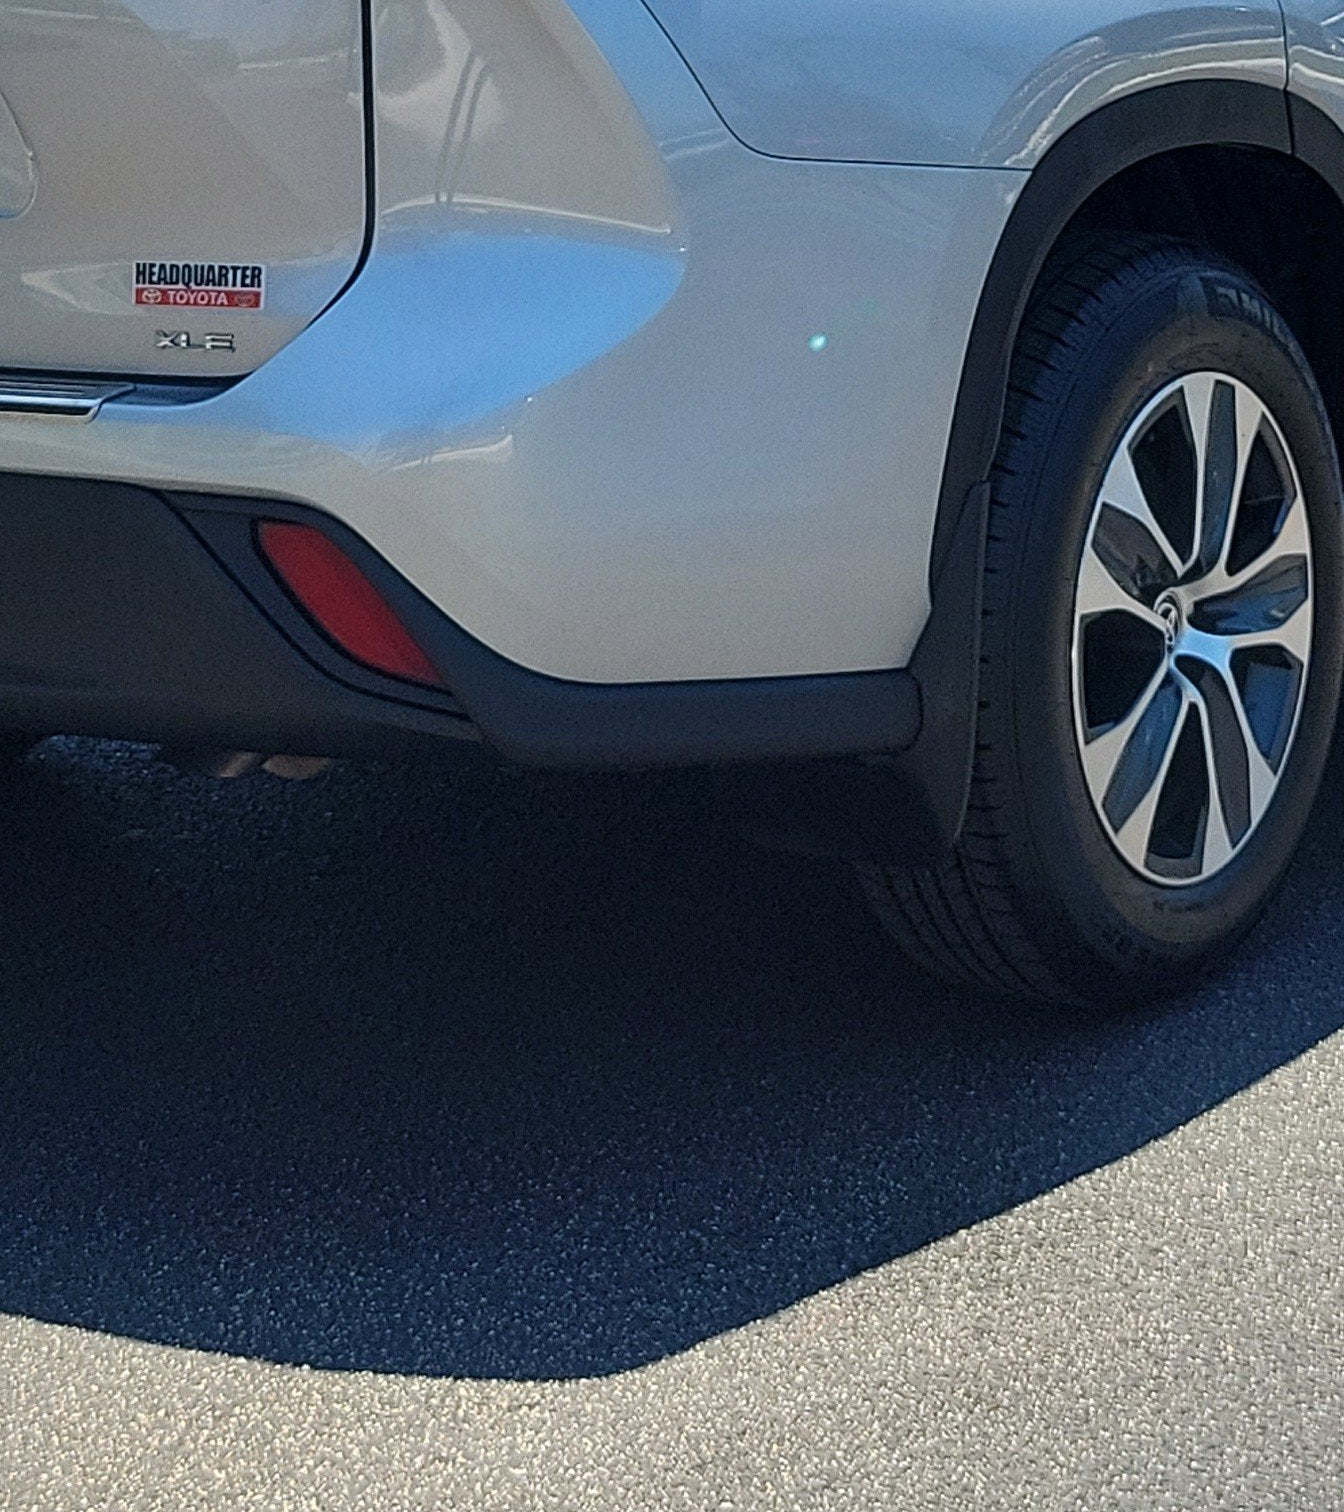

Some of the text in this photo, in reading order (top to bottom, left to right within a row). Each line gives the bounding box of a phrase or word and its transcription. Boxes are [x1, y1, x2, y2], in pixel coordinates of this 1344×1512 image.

[135, 262, 263, 288] HEADQUARTER
[167, 291, 229, 306] TOYOTA
[156, 330, 236, 352] XLE
